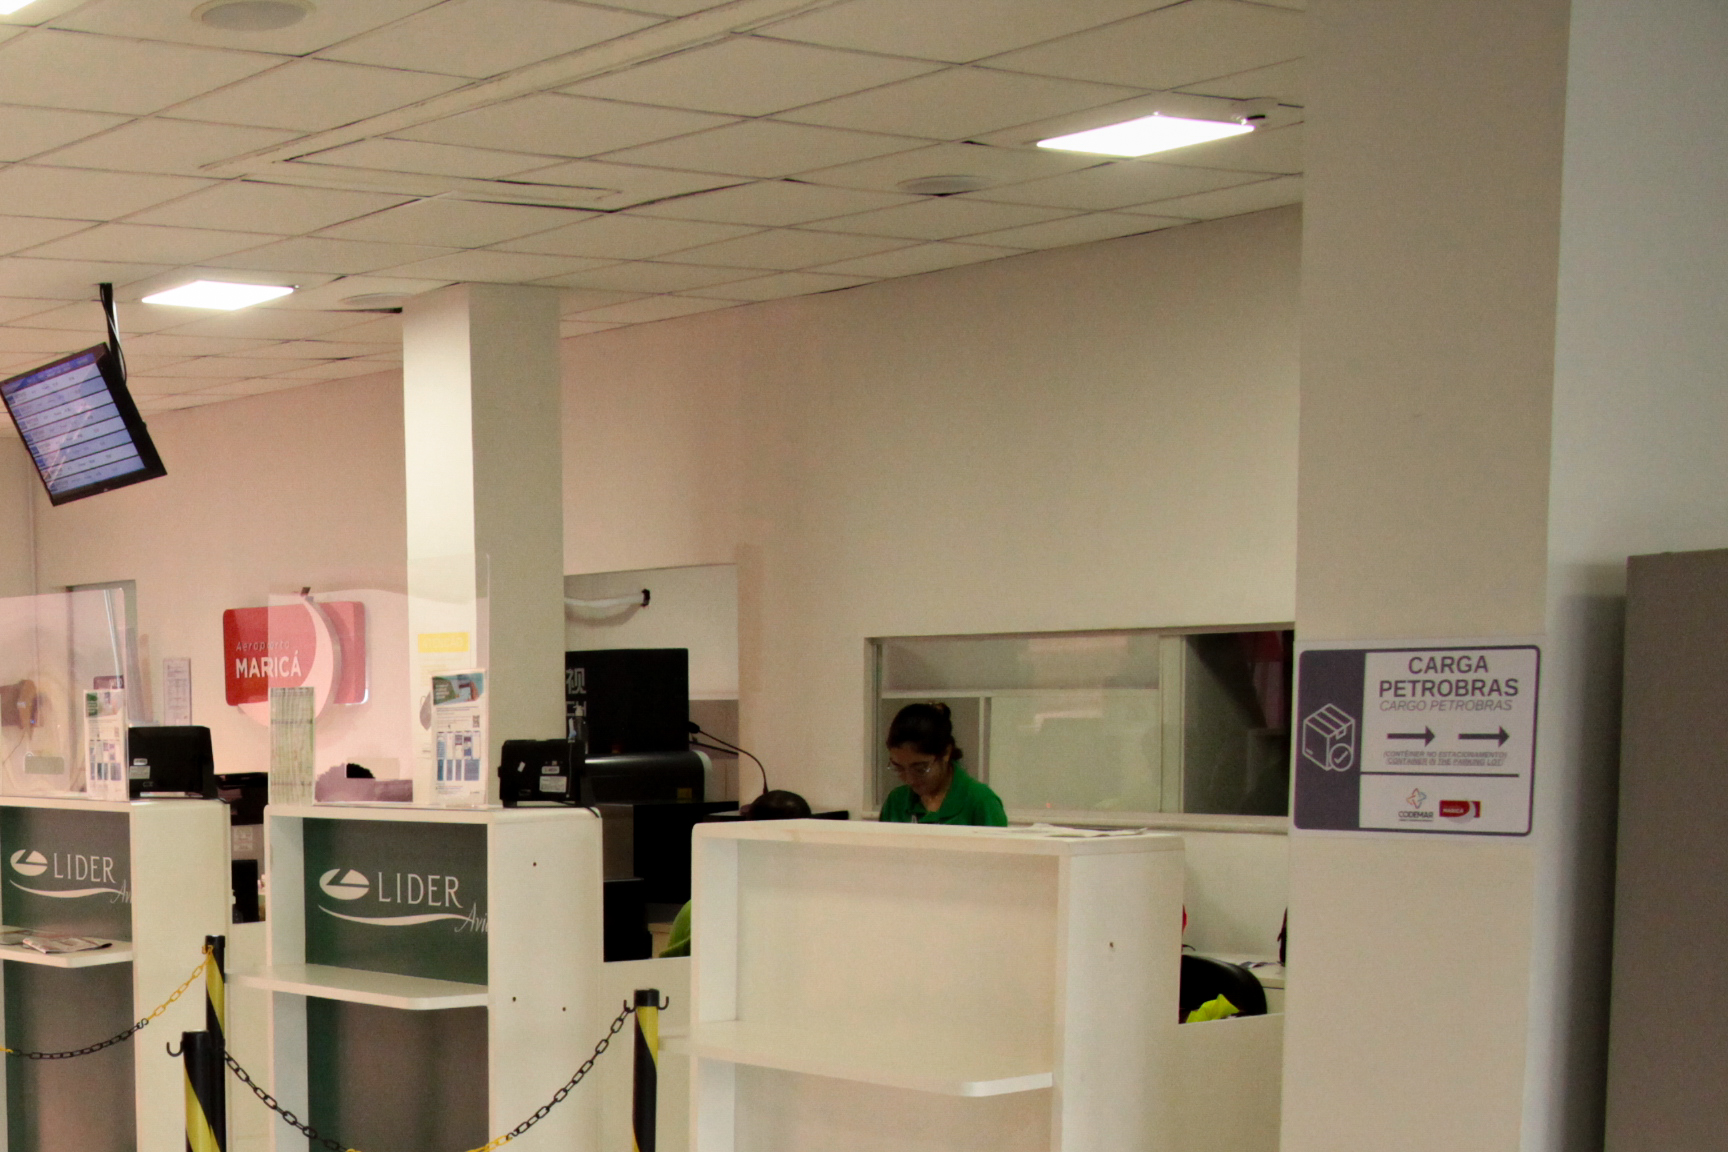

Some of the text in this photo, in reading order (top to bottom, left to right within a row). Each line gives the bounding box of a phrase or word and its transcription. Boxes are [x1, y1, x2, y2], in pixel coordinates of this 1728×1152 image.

[235, 650, 302, 679] MARICÁ
[1408, 655, 1489, 674] CARGA
[1379, 678, 1519, 698] PETROBRAS
[1379, 700, 1513, 711] CARGO PETROBRAS
[53, 852, 117, 884] LIDER
[378, 871, 463, 909] LIDER
